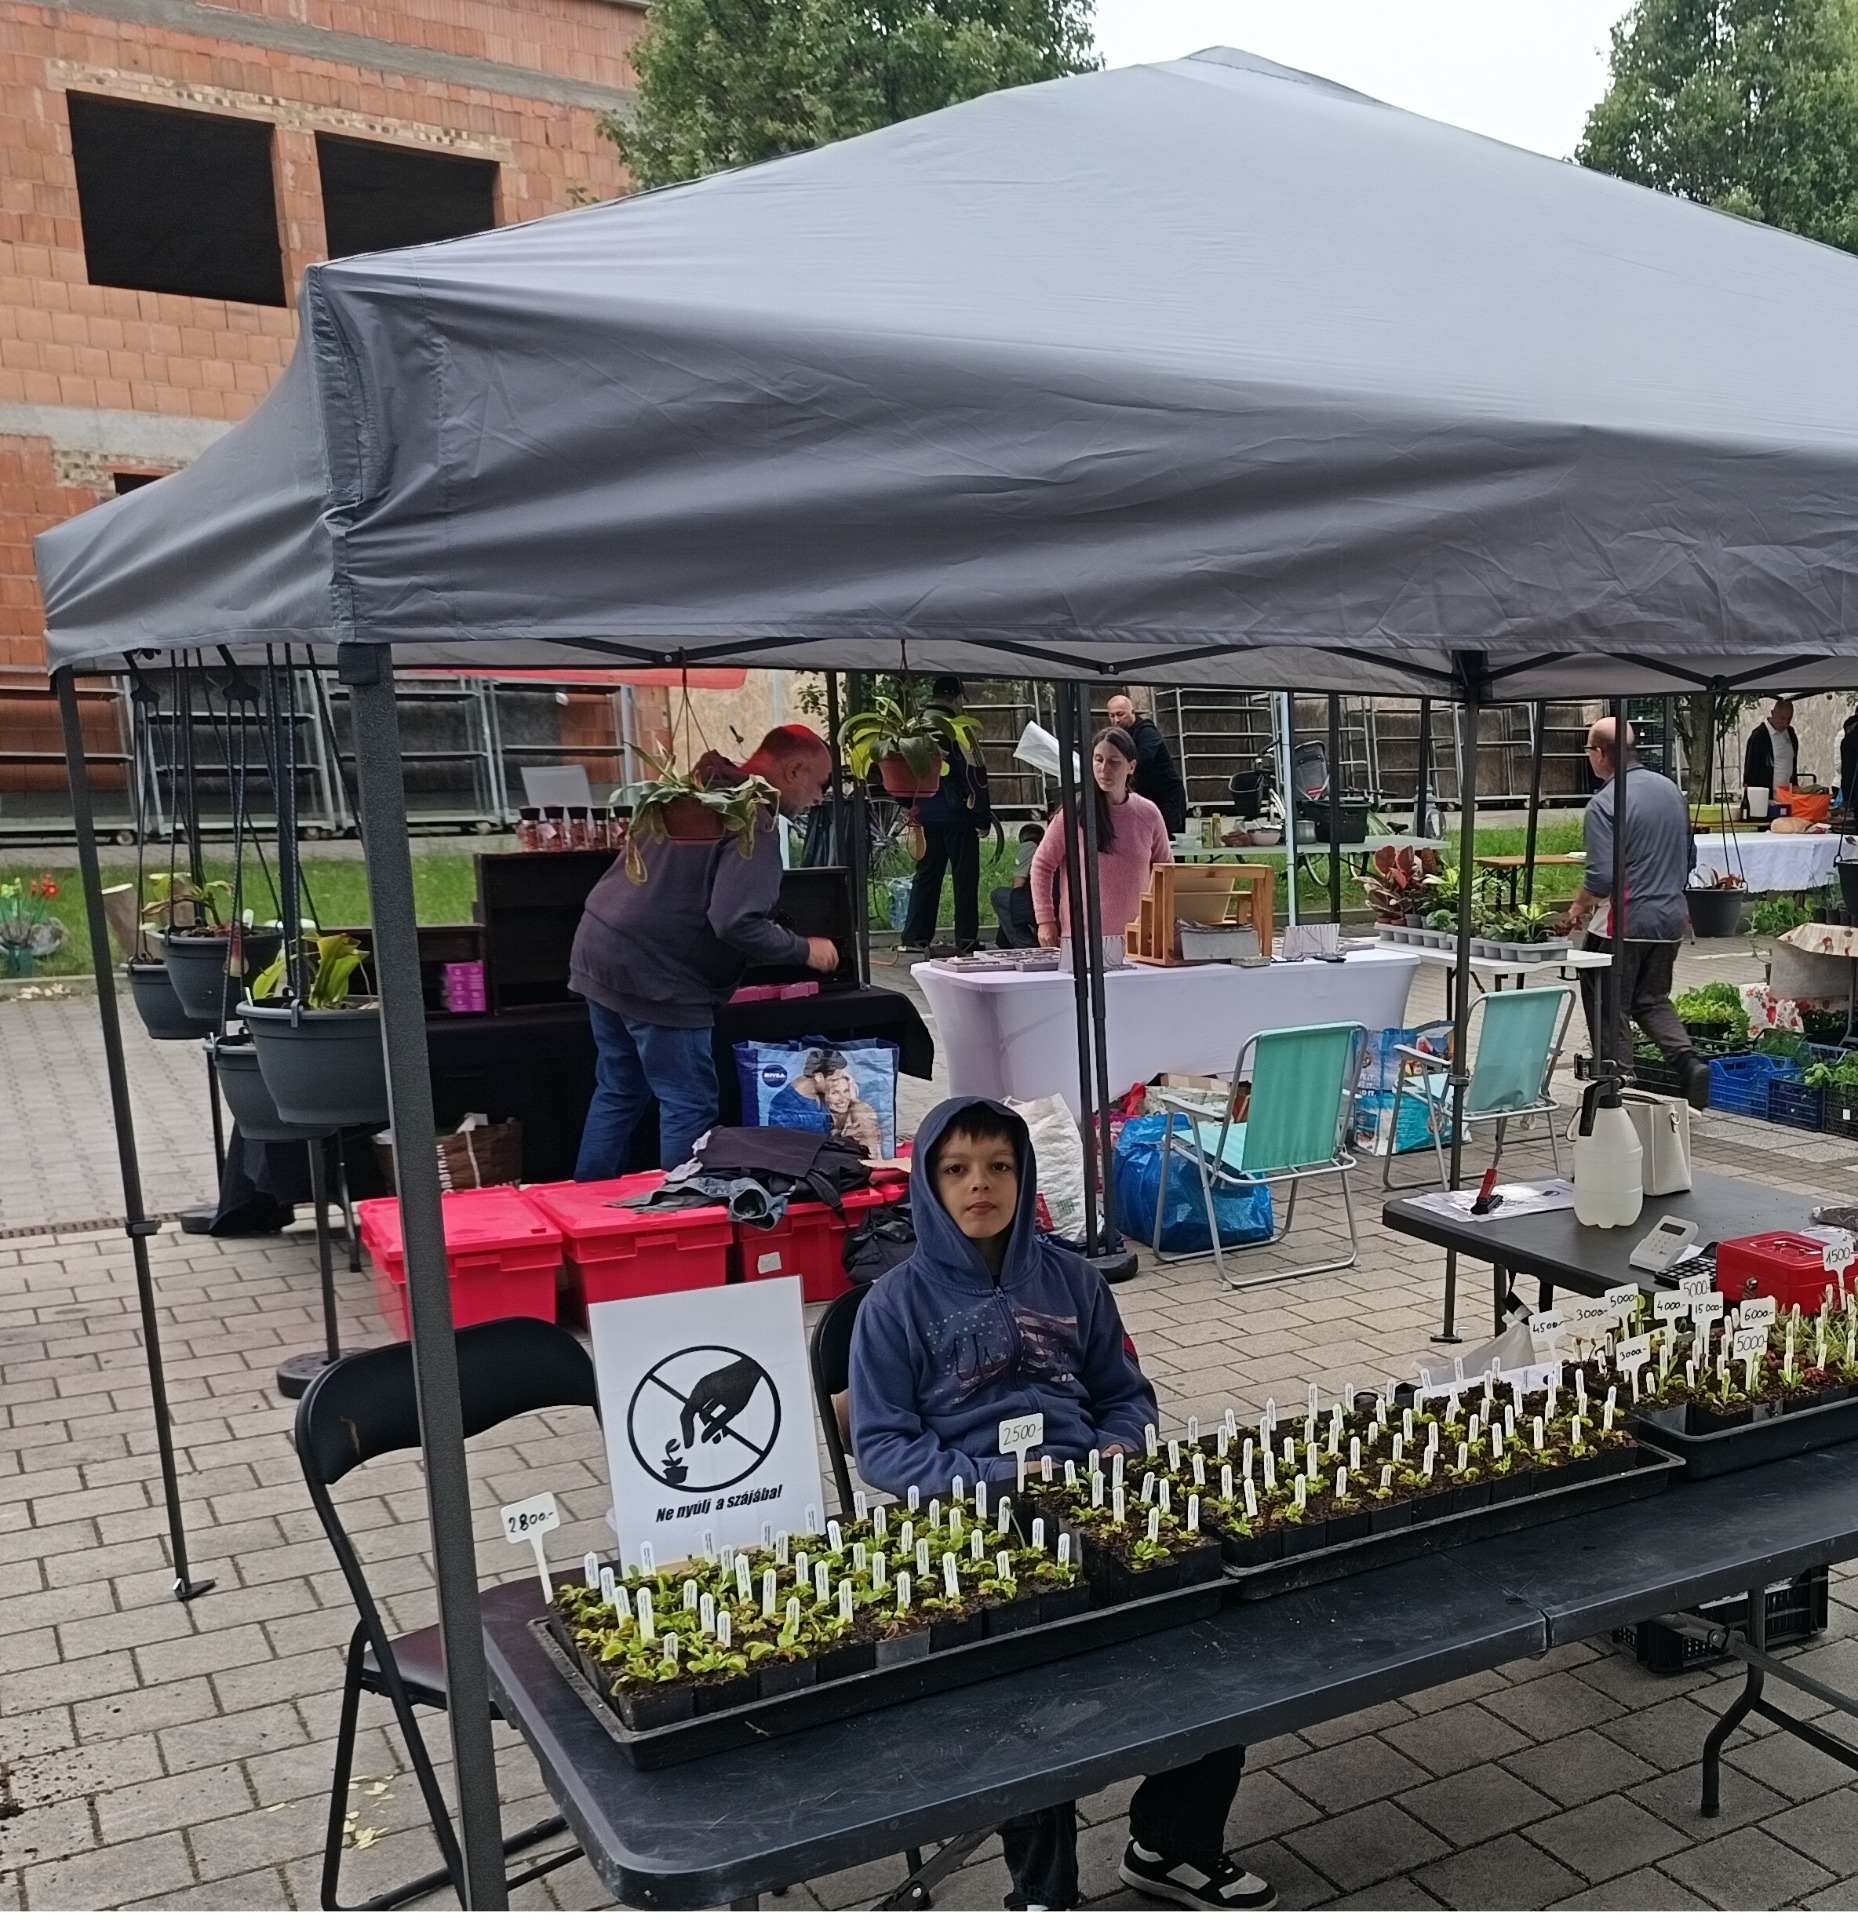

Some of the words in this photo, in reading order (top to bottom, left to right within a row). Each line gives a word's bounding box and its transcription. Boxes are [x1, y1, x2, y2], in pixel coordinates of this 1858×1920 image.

[656, 1507, 674, 1522] Ne
[676, 1498, 712, 1518] nyúlj
[715, 1498, 725, 1511] a
